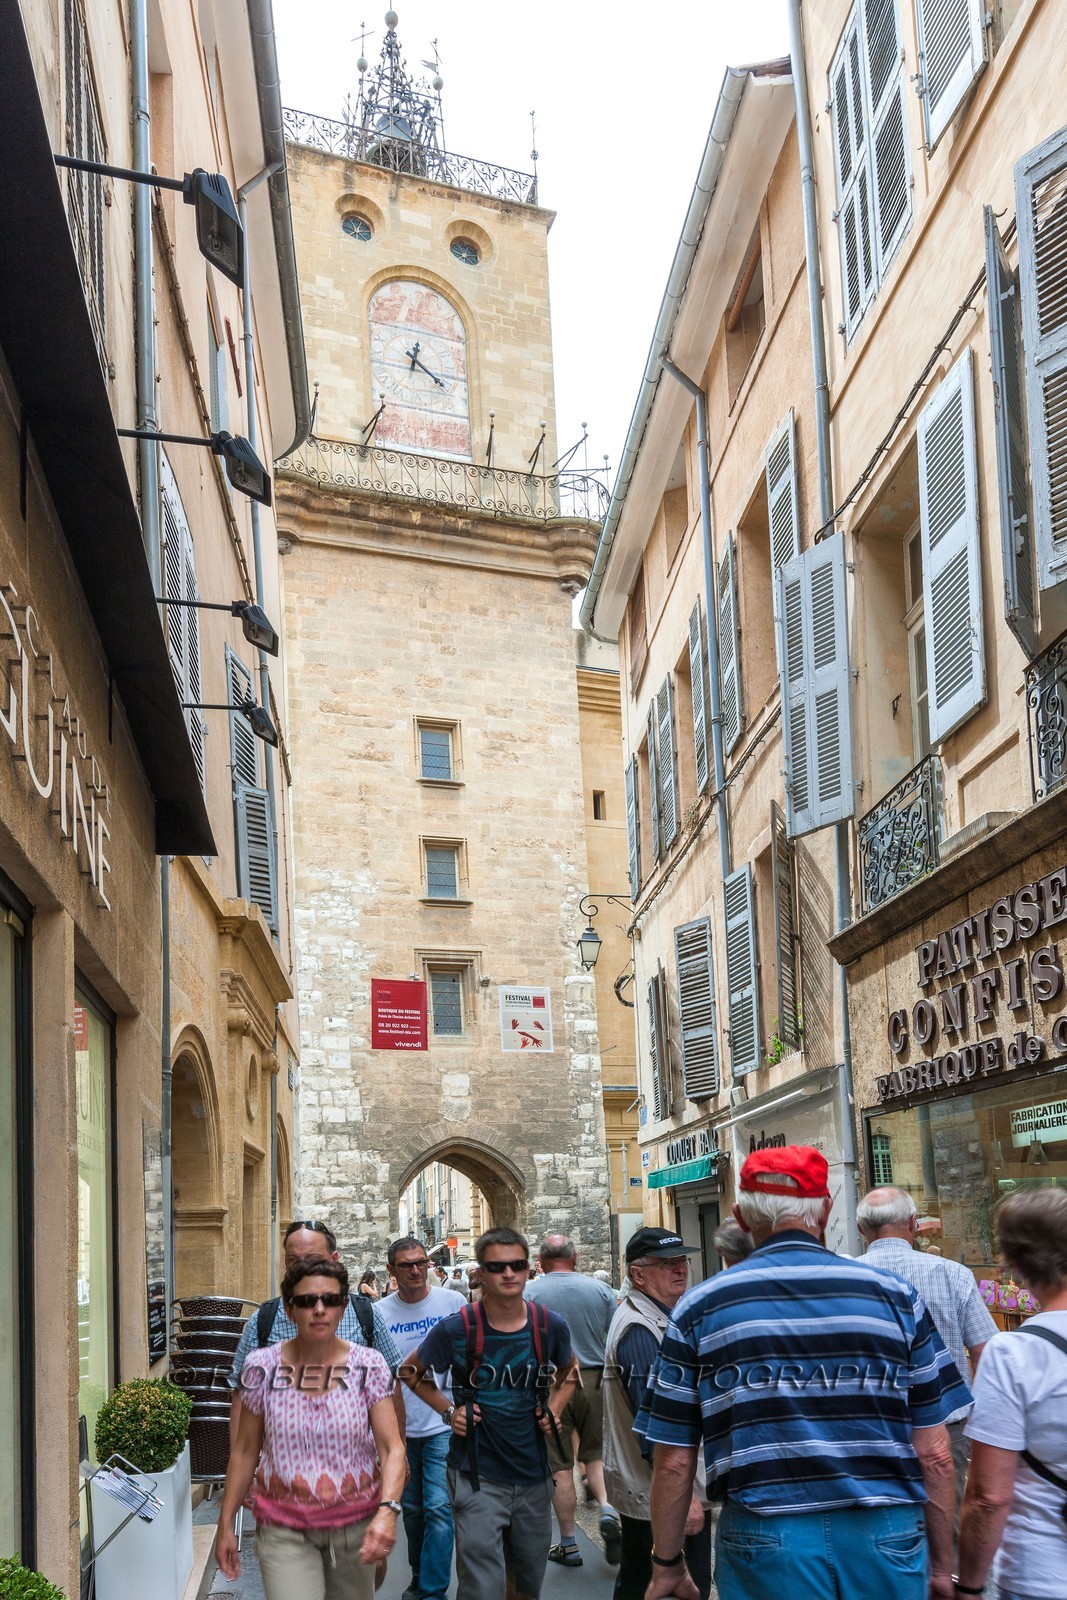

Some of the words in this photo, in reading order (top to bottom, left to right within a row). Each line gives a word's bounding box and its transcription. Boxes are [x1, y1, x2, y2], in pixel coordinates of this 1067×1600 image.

[915, 866, 1067, 988] PATISSE
[888, 944, 1064, 1054] CONFIS
[876, 1036, 1003, 1101] FABRIQUE
[1008, 1032, 1045, 1066] de
